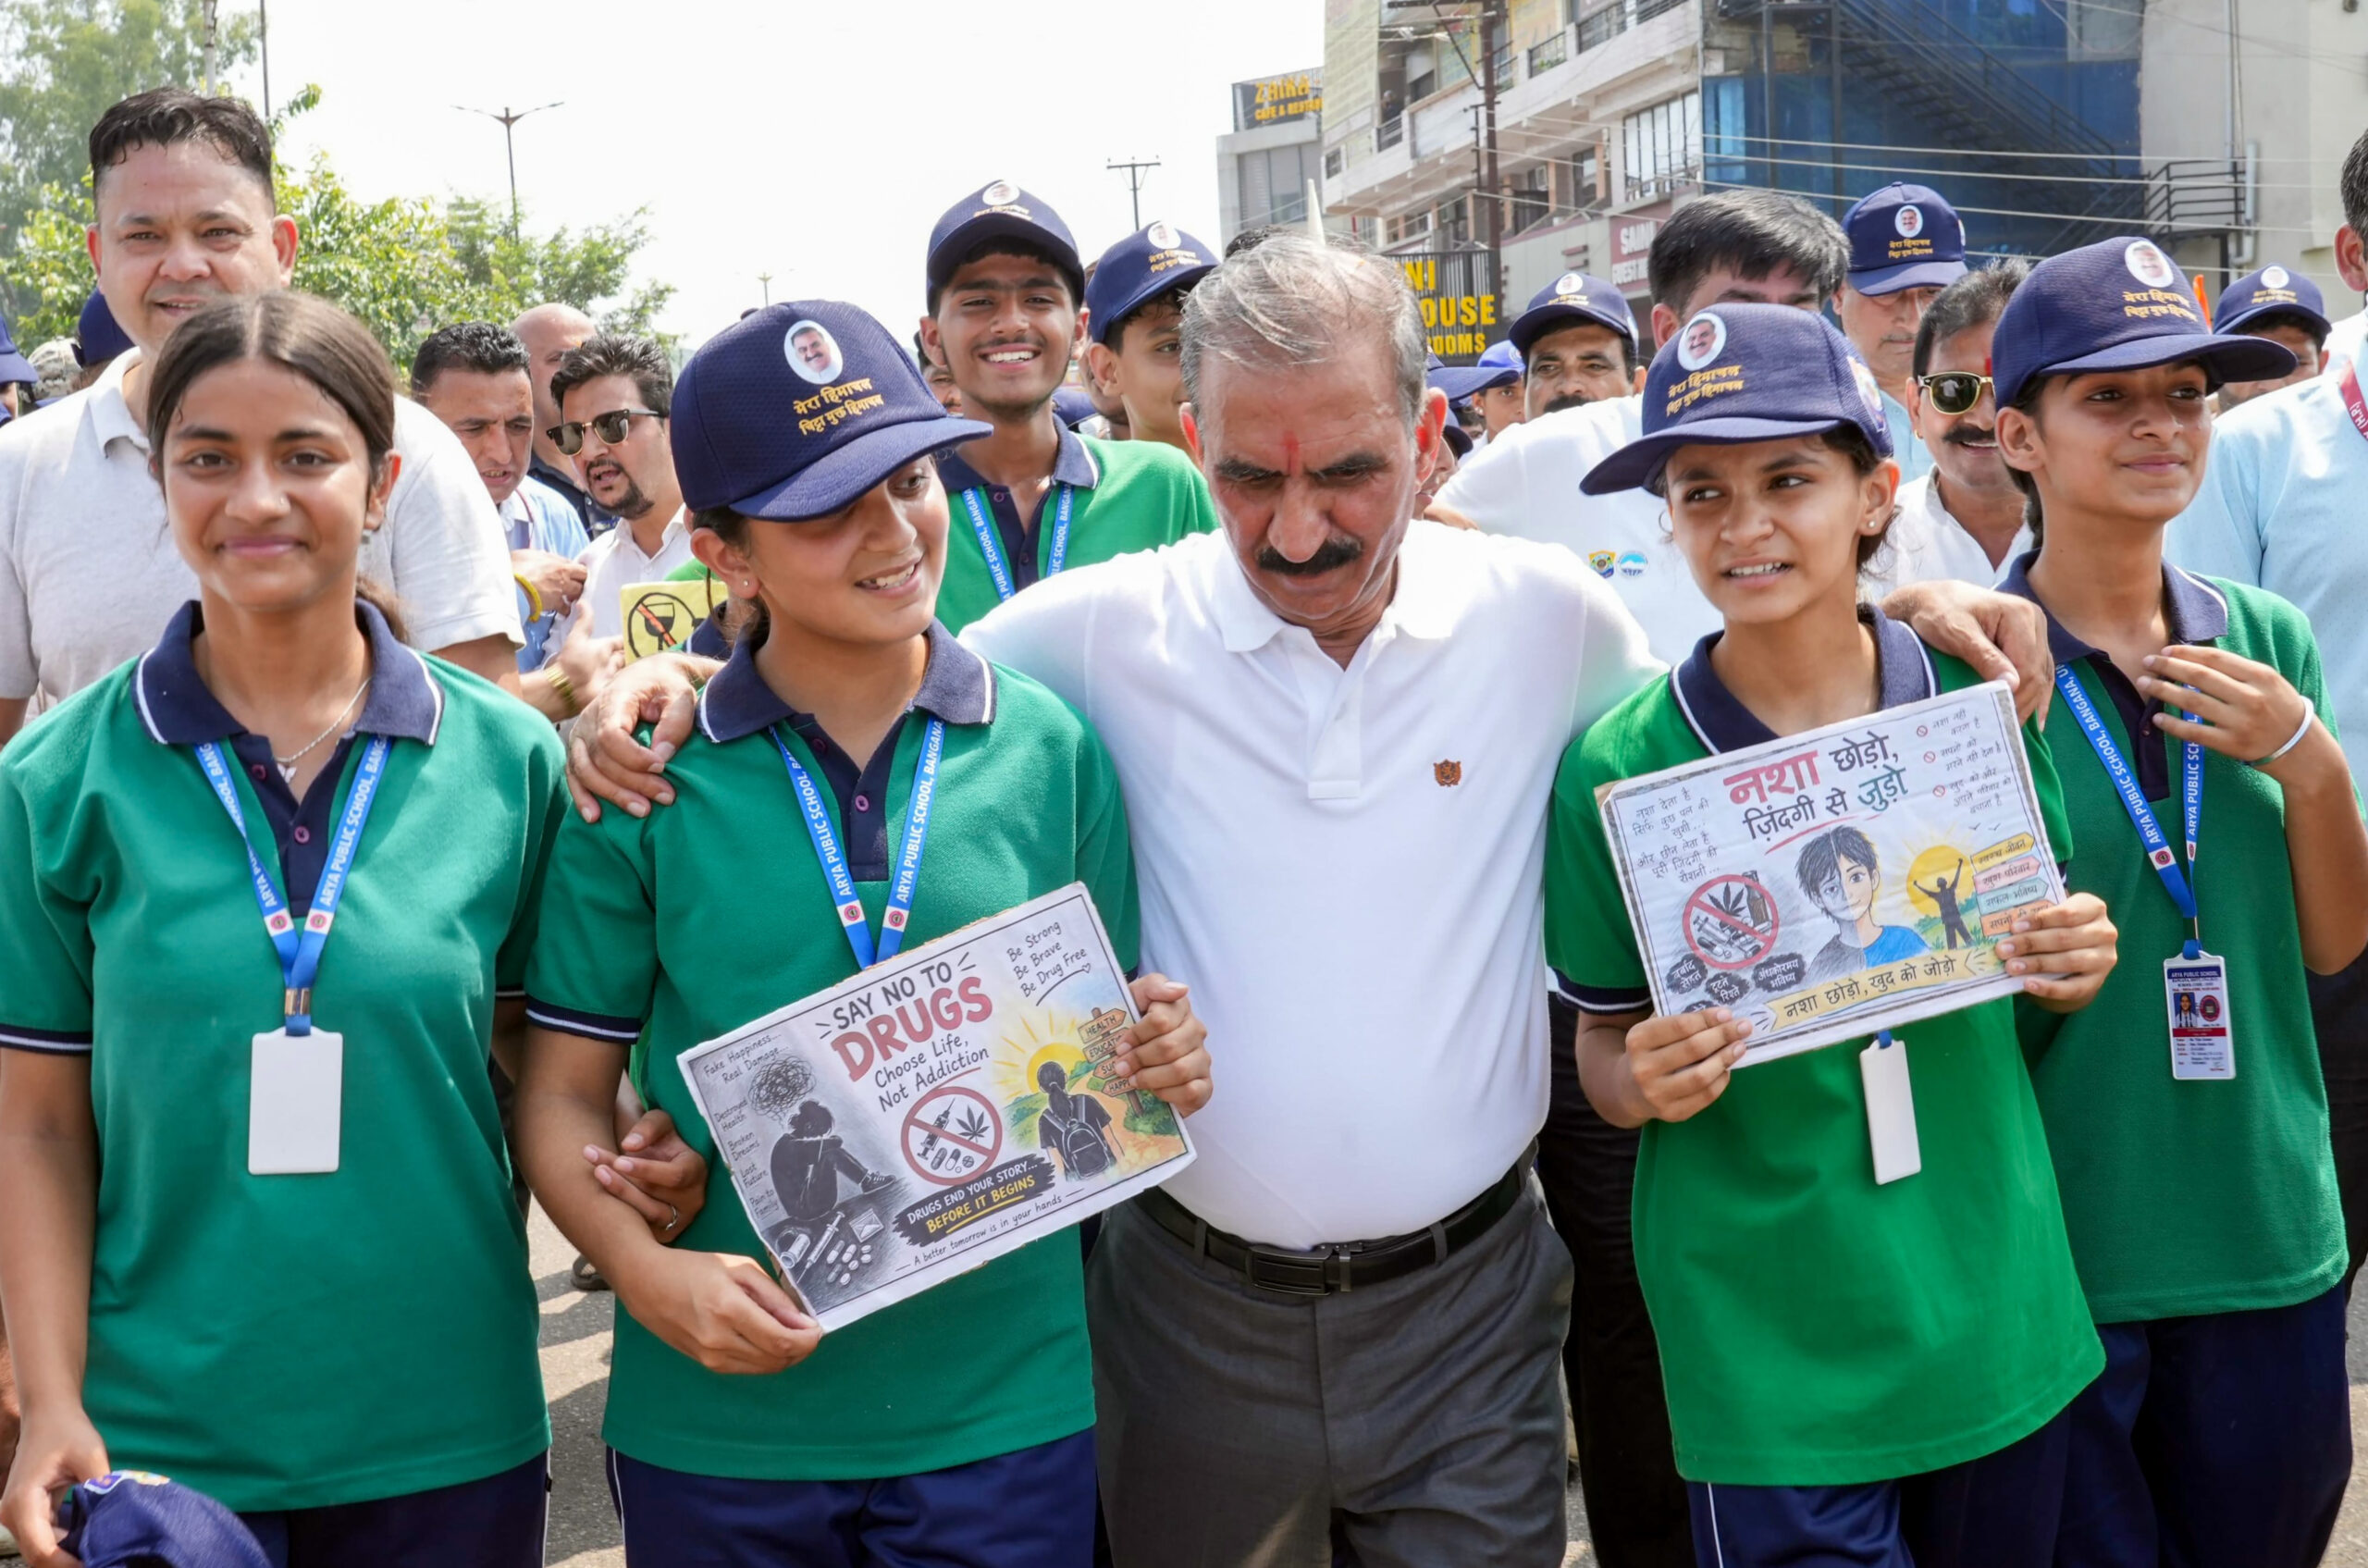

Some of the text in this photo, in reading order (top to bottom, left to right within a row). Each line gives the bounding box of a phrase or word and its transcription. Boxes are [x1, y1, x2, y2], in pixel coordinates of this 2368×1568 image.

[793, 377, 873, 414] मेरा हिमाचल
[2064, 675, 2102, 732] BANGANA,
[1722, 731, 1899, 805] नशा छोड़ो,
[2095, 729, 2131, 776] SCHOOL,
[346, 775, 377, 827] SCHOOL,
[912, 777, 933, 825] SCHOOL,
[1636, 786, 1692, 819] नशा देता है
[1825, 787, 1849, 816] से
[1857, 763, 1909, 812] जुड़ो
[2119, 775, 2150, 817] PUBLIC
[2187, 763, 2200, 804] PUBLIC
[796, 771, 853, 897] ARYA PUBLIC SCHOOL,
[2142, 816, 2162, 845] ARYA
[2188, 806, 2198, 836] ARYA
[336, 827, 357, 873] PUBLIC
[904, 824, 924, 868] PUBLIC
[256, 872, 278, 908] ARYA
[319, 870, 341, 907] ARYA
[895, 870, 915, 905] ARYA
[1006, 921, 1062, 963] Be Strong
[1013, 941, 1062, 981] Be Brave
[1020, 947, 1088, 998] Be Drug Free
[1783, 993, 1819, 1019] नशा
[1868, 973, 1895, 993] खुद
[1901, 962, 1918, 982] को
[1923, 954, 1957, 978] जोड़ो
[832, 961, 953, 1030] SAY NO TO
[830, 976, 993, 1082] DRUGS
[1086, 1014, 1116, 1036] HEALTH
[703, 1063, 725, 1079] Fake
[722, 1068, 743, 1085] Real
[874, 1032, 969, 1089] Choose Life,
[878, 1046, 990, 1113] Not Addiction
[722, 1113, 747, 1133] Health
[727, 1130, 756, 1152] Broken
[732, 1140, 761, 1162] Dreams
[740, 1162, 758, 1179] Lost
[743, 1169, 770, 1191] Future
[906, 1160, 1039, 1225] DRUGS END YOUR STORY...
[754, 1200, 781, 1221] Family
[926, 1174, 1036, 1234] BEFORE IT BEGINS
[914, 1194, 1063, 1266] A better tomorrow is in your hands
